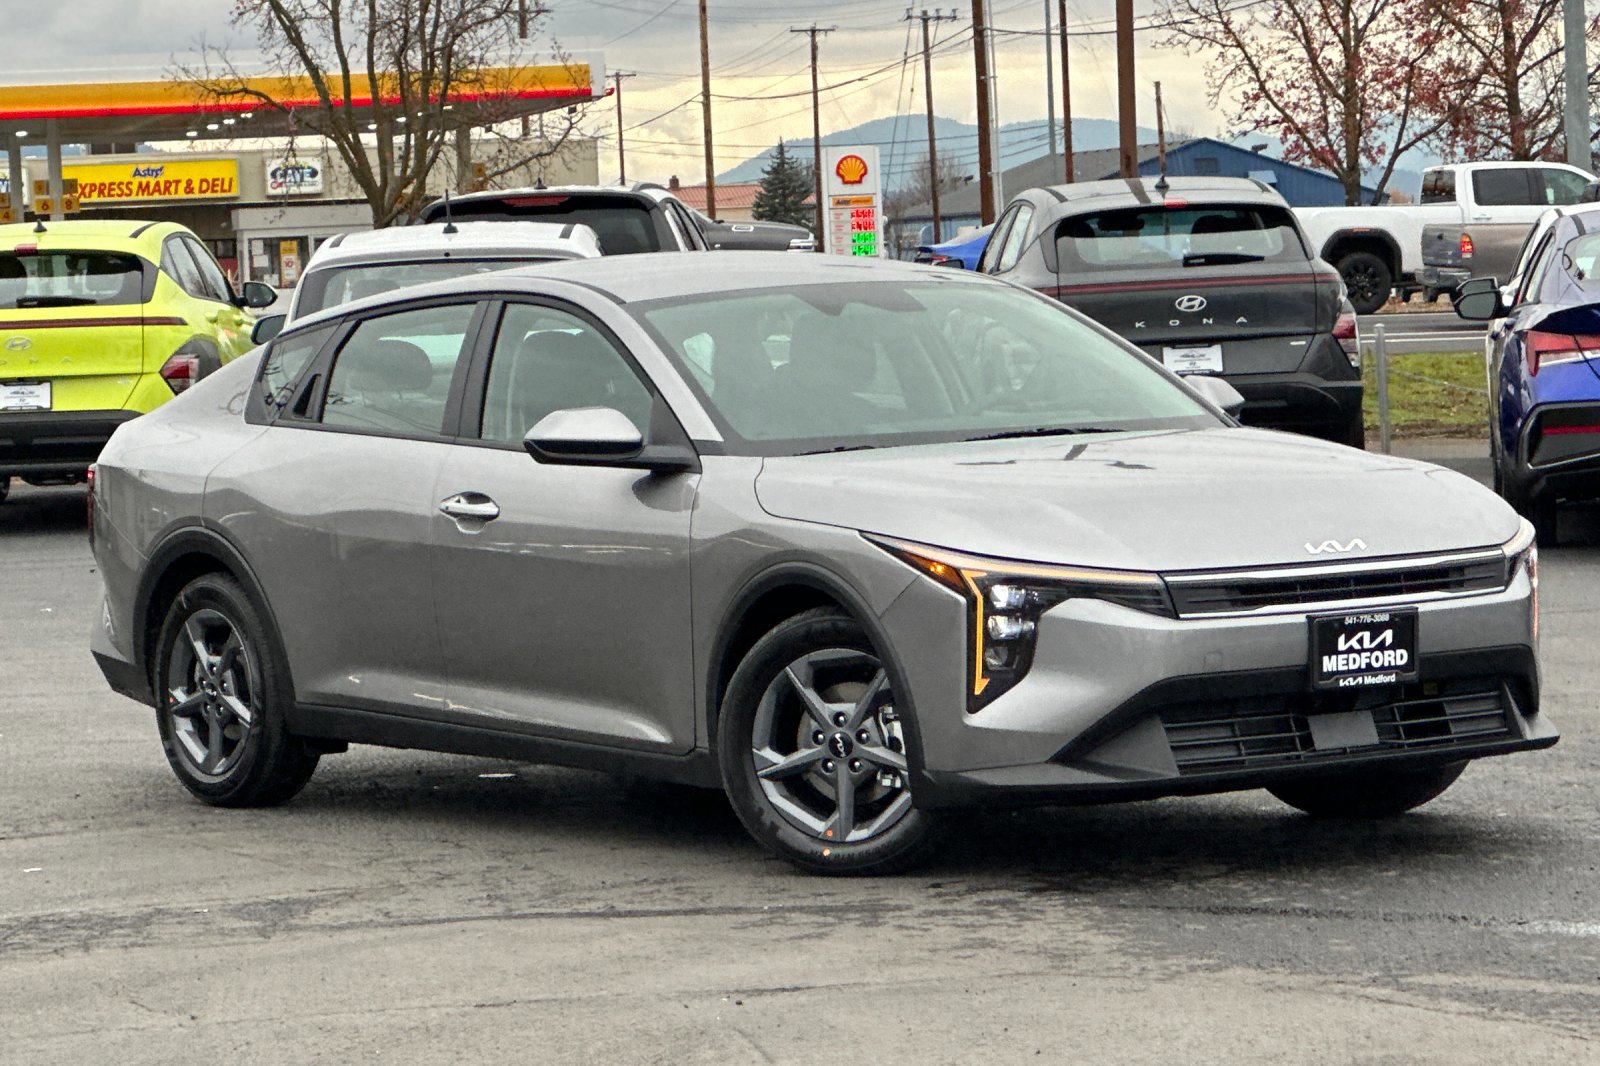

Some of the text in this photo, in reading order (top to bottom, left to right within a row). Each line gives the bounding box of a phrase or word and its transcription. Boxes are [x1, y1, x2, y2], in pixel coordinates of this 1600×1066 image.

[72, 181, 133, 200] XPRESS
[136, 179, 182, 197] MART
[184, 179, 195, 195] &
[198, 177, 234, 195] DELI
[1135, 316, 1248, 328] KONA
[1338, 629, 1393, 651] KIA
[1322, 649, 1408, 673] MEDFORD
[1364, 673, 1396, 685] Medford
